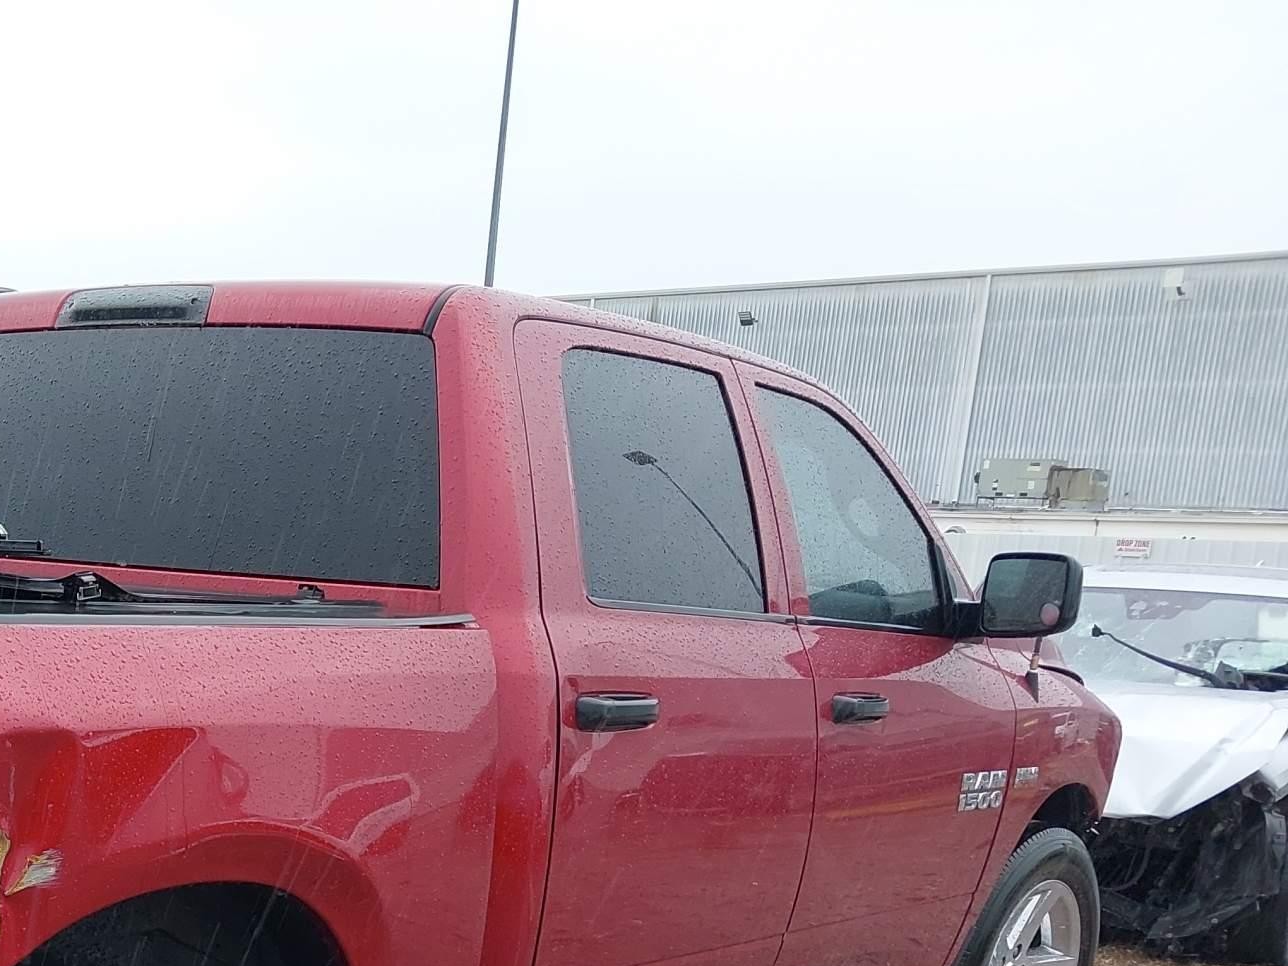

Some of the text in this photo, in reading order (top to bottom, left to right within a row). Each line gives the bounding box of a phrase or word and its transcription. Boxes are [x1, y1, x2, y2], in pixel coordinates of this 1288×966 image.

[1116, 539, 1151, 548] DROP ZONE
[961, 770, 1008, 791] RAM
[958, 791, 1003, 812] 1500
